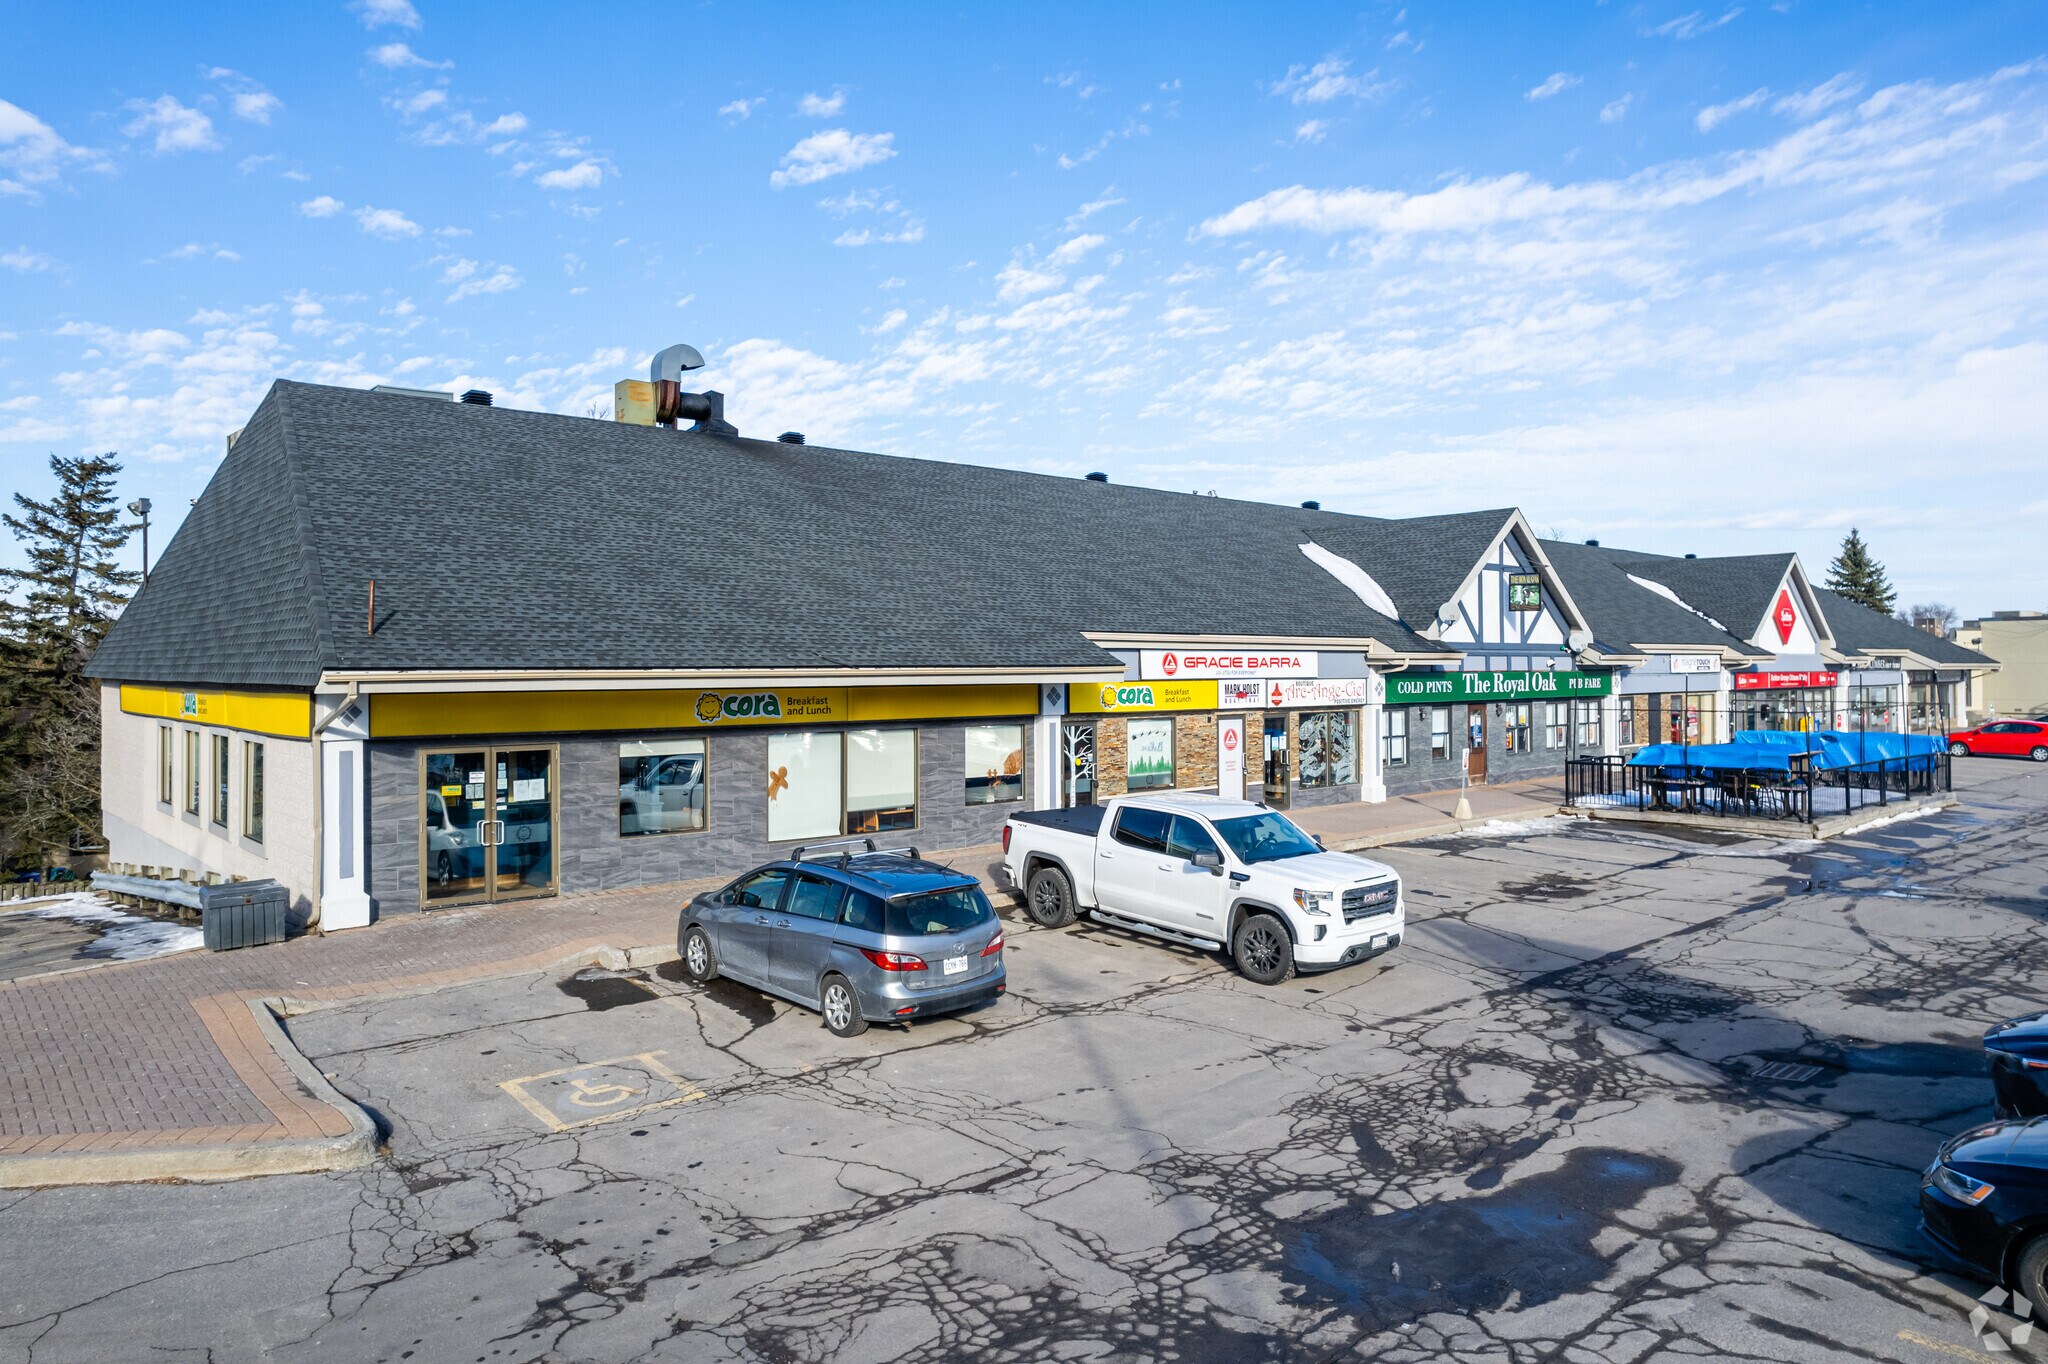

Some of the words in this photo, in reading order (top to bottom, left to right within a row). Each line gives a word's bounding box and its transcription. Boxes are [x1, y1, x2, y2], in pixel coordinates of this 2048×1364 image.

[1184, 656, 1243, 668] GRACIE
[1247, 657, 1301, 669] BARRA
[1224, 683, 1241, 695] MARK
[1242, 683, 1260, 694] HOLST
[1397, 681, 1424, 694] COLD
[1426, 680, 1453, 693] PINTS
[1462, 673, 1491, 694] The
[1492, 672, 1530, 698] Royal
[1531, 672, 1557, 692] Oak
[1568, 677, 1583, 689] PUB
[1584, 677, 1602, 688] FARE
[787, 697, 828, 706] Breakfast
[1117, 687, 1153, 705] cora
[723, 694, 780, 716] cora
[787, 707, 804, 715] and
[806, 705, 831, 714] Lunch
